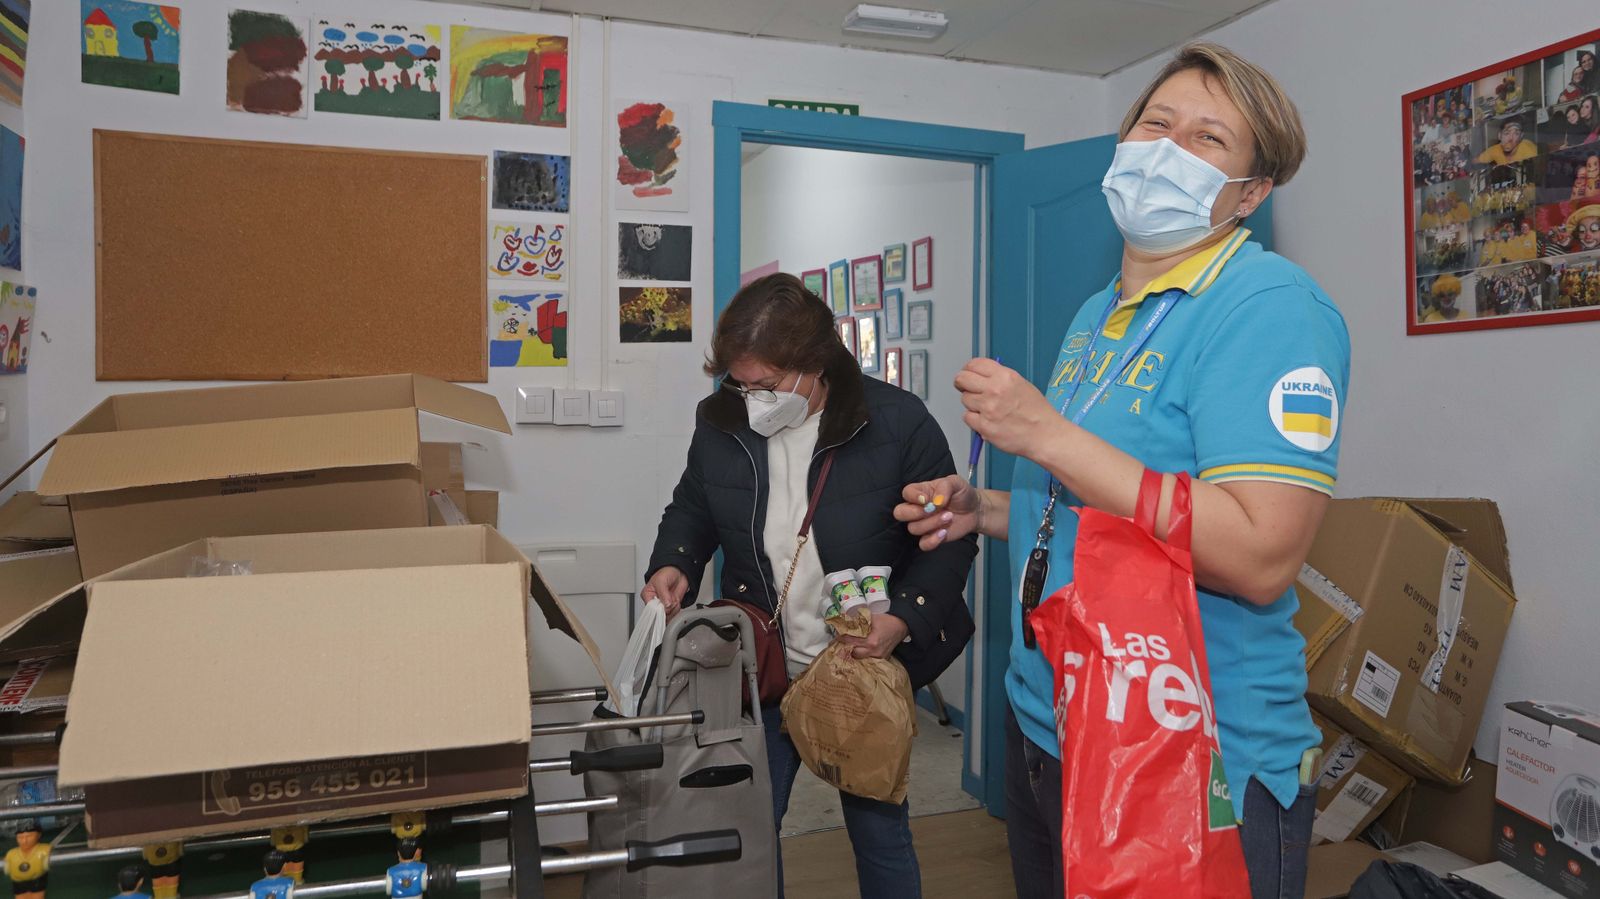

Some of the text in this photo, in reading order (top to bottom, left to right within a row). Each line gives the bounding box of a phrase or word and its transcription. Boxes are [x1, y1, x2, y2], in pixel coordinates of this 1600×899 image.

[1282, 382, 1333, 397] UKRAINE
[1098, 622, 1171, 661] Las
[1407, 657, 1421, 674] PCS
[1438, 682, 1462, 705] QUANTI
[1505, 759, 1527, 772] HEATER
[1506, 747, 1556, 775] CALEFACTOR
[249, 766, 415, 801] 956 455 021
